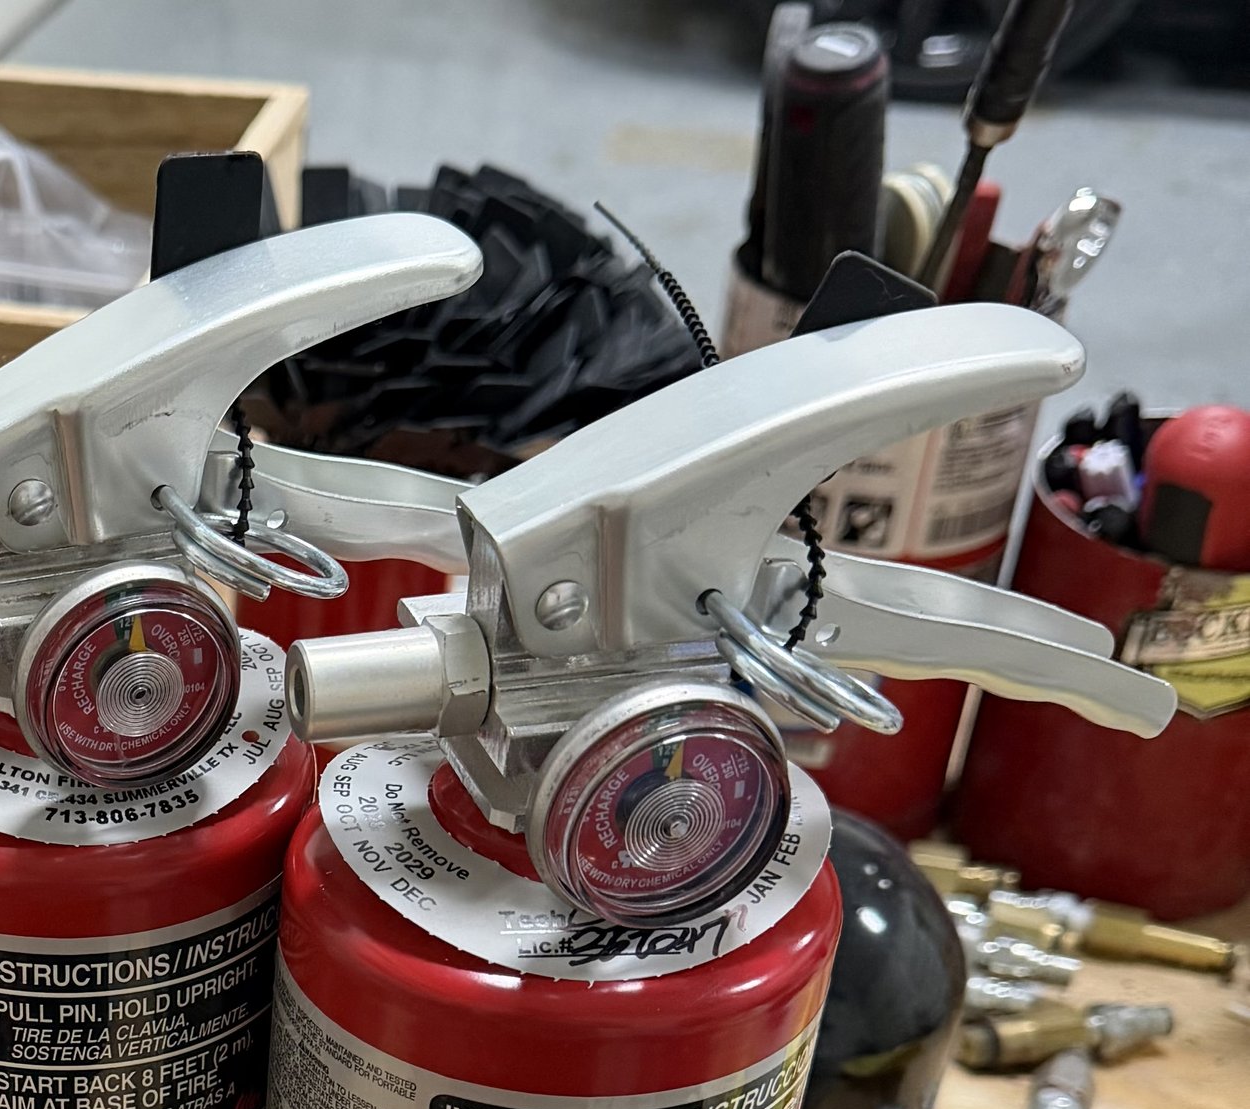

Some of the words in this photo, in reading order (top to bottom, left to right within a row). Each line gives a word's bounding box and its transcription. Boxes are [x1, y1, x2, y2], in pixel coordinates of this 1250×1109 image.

[177, 630, 190, 647] 250
[71, 641, 97, 716] RECHARGE
[269, 667, 284, 692] SEP
[58, 721, 76, 740] USE
[121, 722, 171, 751] CHEMICAL
[170, 703, 192, 728] ONLY
[263, 699, 285, 732] AUG
[243, 739, 271, 765] JUL
[346, 752, 368, 771] AUG
[104, 761, 220, 805] SUMMERVILLE
[217, 743, 239, 761] TX
[333, 774, 352, 798] SEP
[385, 783, 403, 798] Do
[45, 789, 200, 825] 713-806-7835
[336, 804, 362, 832] OCT
[388, 802, 410, 825] Not
[595, 768, 630, 850] RECHARGE
[353, 840, 393, 873] NOV
[384, 842, 435, 880] 2029
[402, 827, 470, 881] Remove
[749, 871, 783, 904] JAN
[776, 833, 801, 866] FEB
[638, 862, 698, 889] CHEMICAL
[390, 877, 438, 912] DEC
[59, 1005, 103, 1023] PIN.
[108, 994, 170, 1022] HOLD
[176, 957, 259, 1008] UPRIGHT.
[372, 1074, 417, 1101] PORTABLE
[385, 1072, 417, 1092] TESTED
